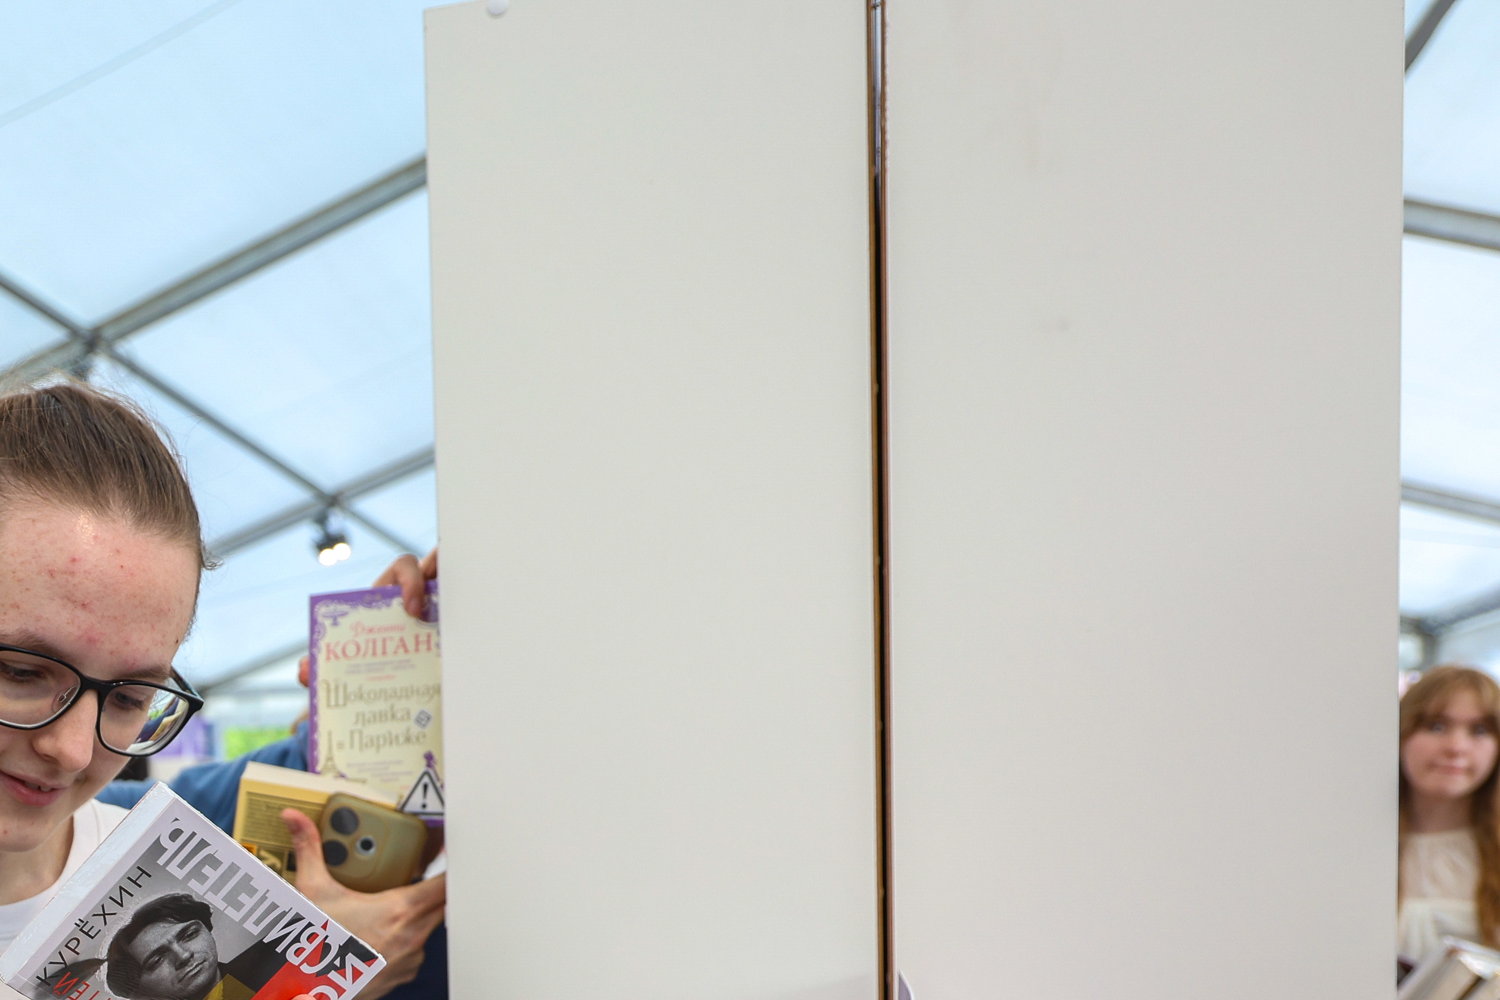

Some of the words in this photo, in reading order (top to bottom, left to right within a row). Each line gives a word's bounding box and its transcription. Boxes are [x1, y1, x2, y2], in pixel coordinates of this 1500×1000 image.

[325, 632, 433, 661] КОЛГАН
[354, 706, 411, 727] лавка
[349, 730, 427, 755] Париже
[157, 818, 346, 975] СВИДЕТЕЛЬ
[36, 866, 152, 987] КУРЁХИН
